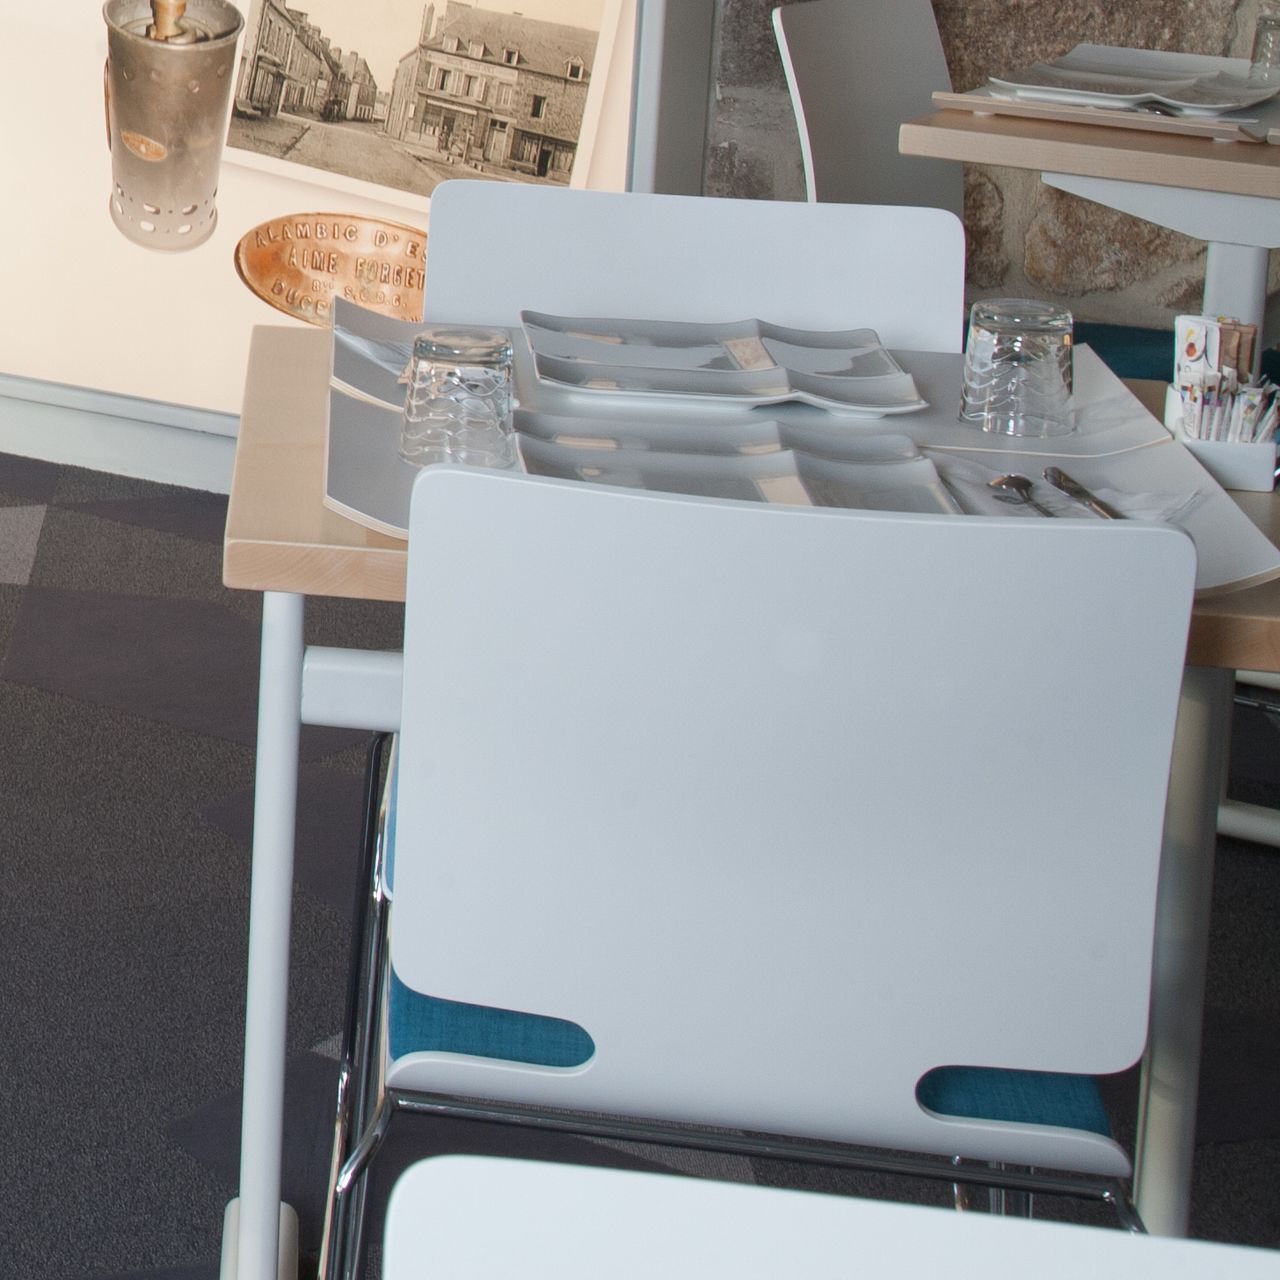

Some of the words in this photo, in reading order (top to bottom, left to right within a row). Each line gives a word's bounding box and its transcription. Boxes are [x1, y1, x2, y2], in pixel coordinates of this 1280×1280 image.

[255, 223, 358, 248] ALAMBIC
[288, 247, 338, 274] AIME
[355, 257, 425, 291] FORGET
[271, 279, 333, 316] DUCE
